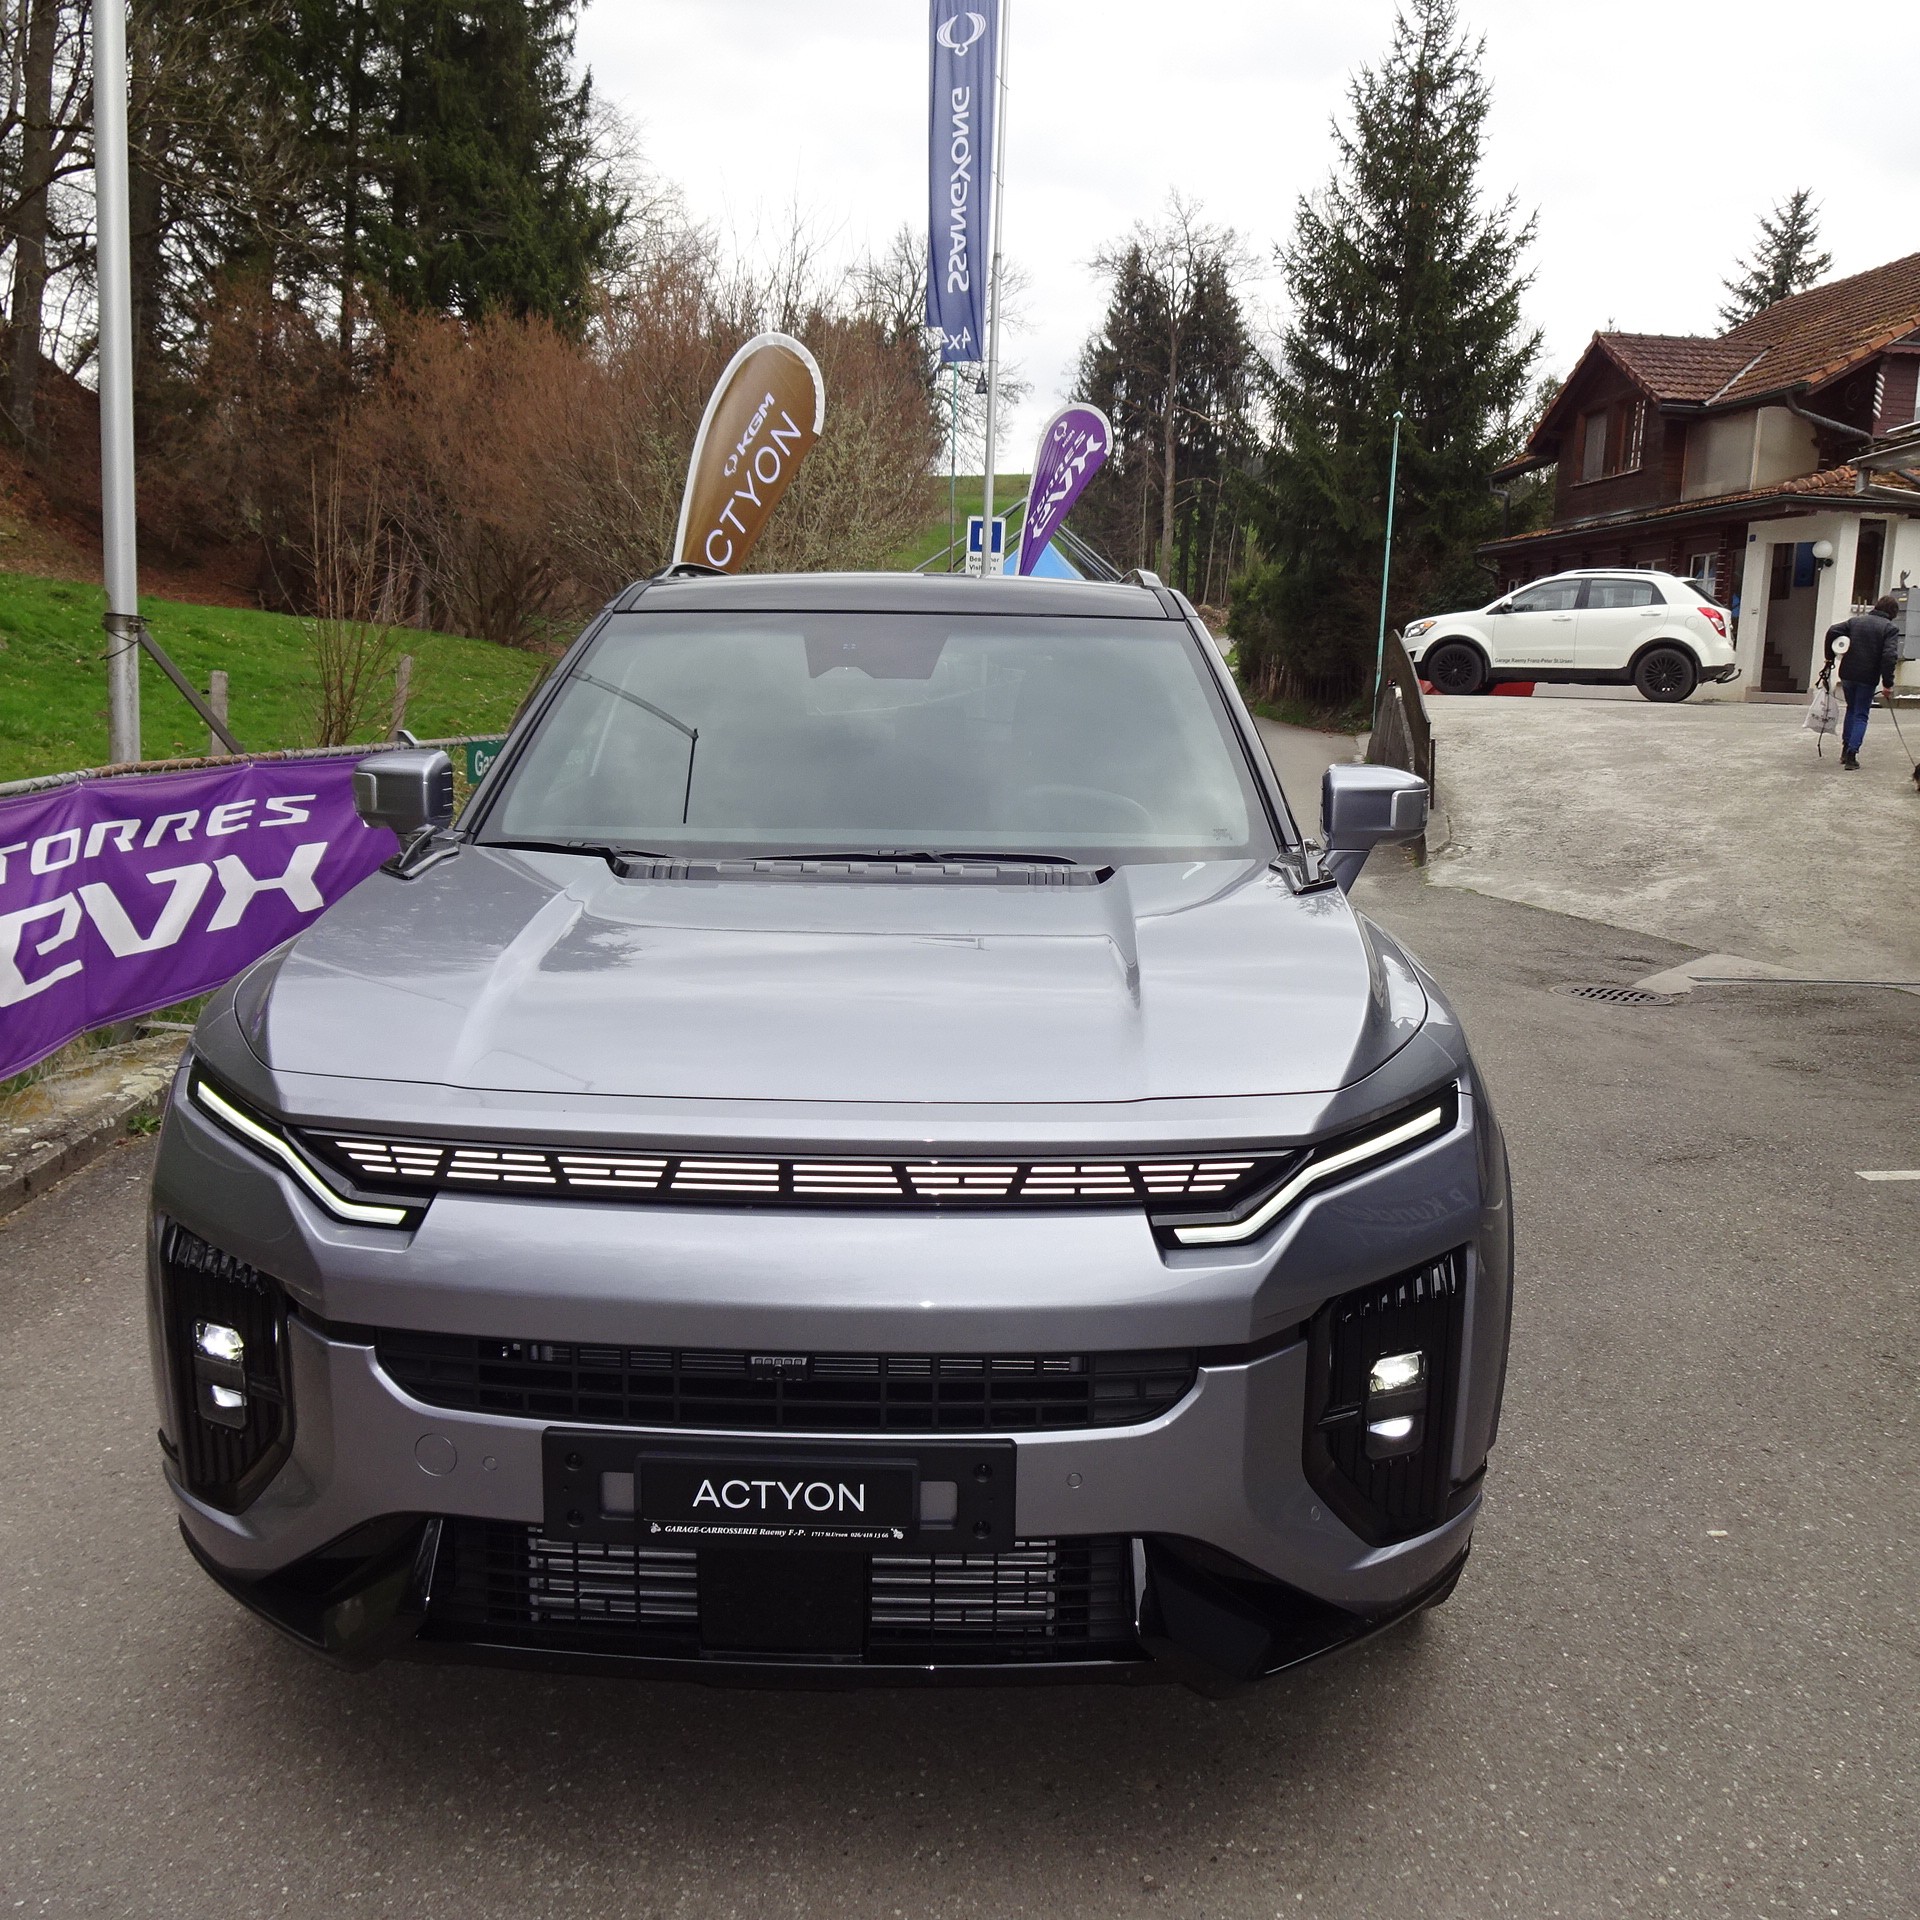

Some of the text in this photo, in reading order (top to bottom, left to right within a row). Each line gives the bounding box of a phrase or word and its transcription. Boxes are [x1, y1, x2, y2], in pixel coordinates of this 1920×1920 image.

[736, 392, 775, 456] KGM
[705, 411, 802, 567] CTYON
[692, 1479, 866, 1513] ACTYON
[665, 1525, 758, 1536] GARAGE-CARROSSERIE
[759, 1528, 787, 1538] Raemy
